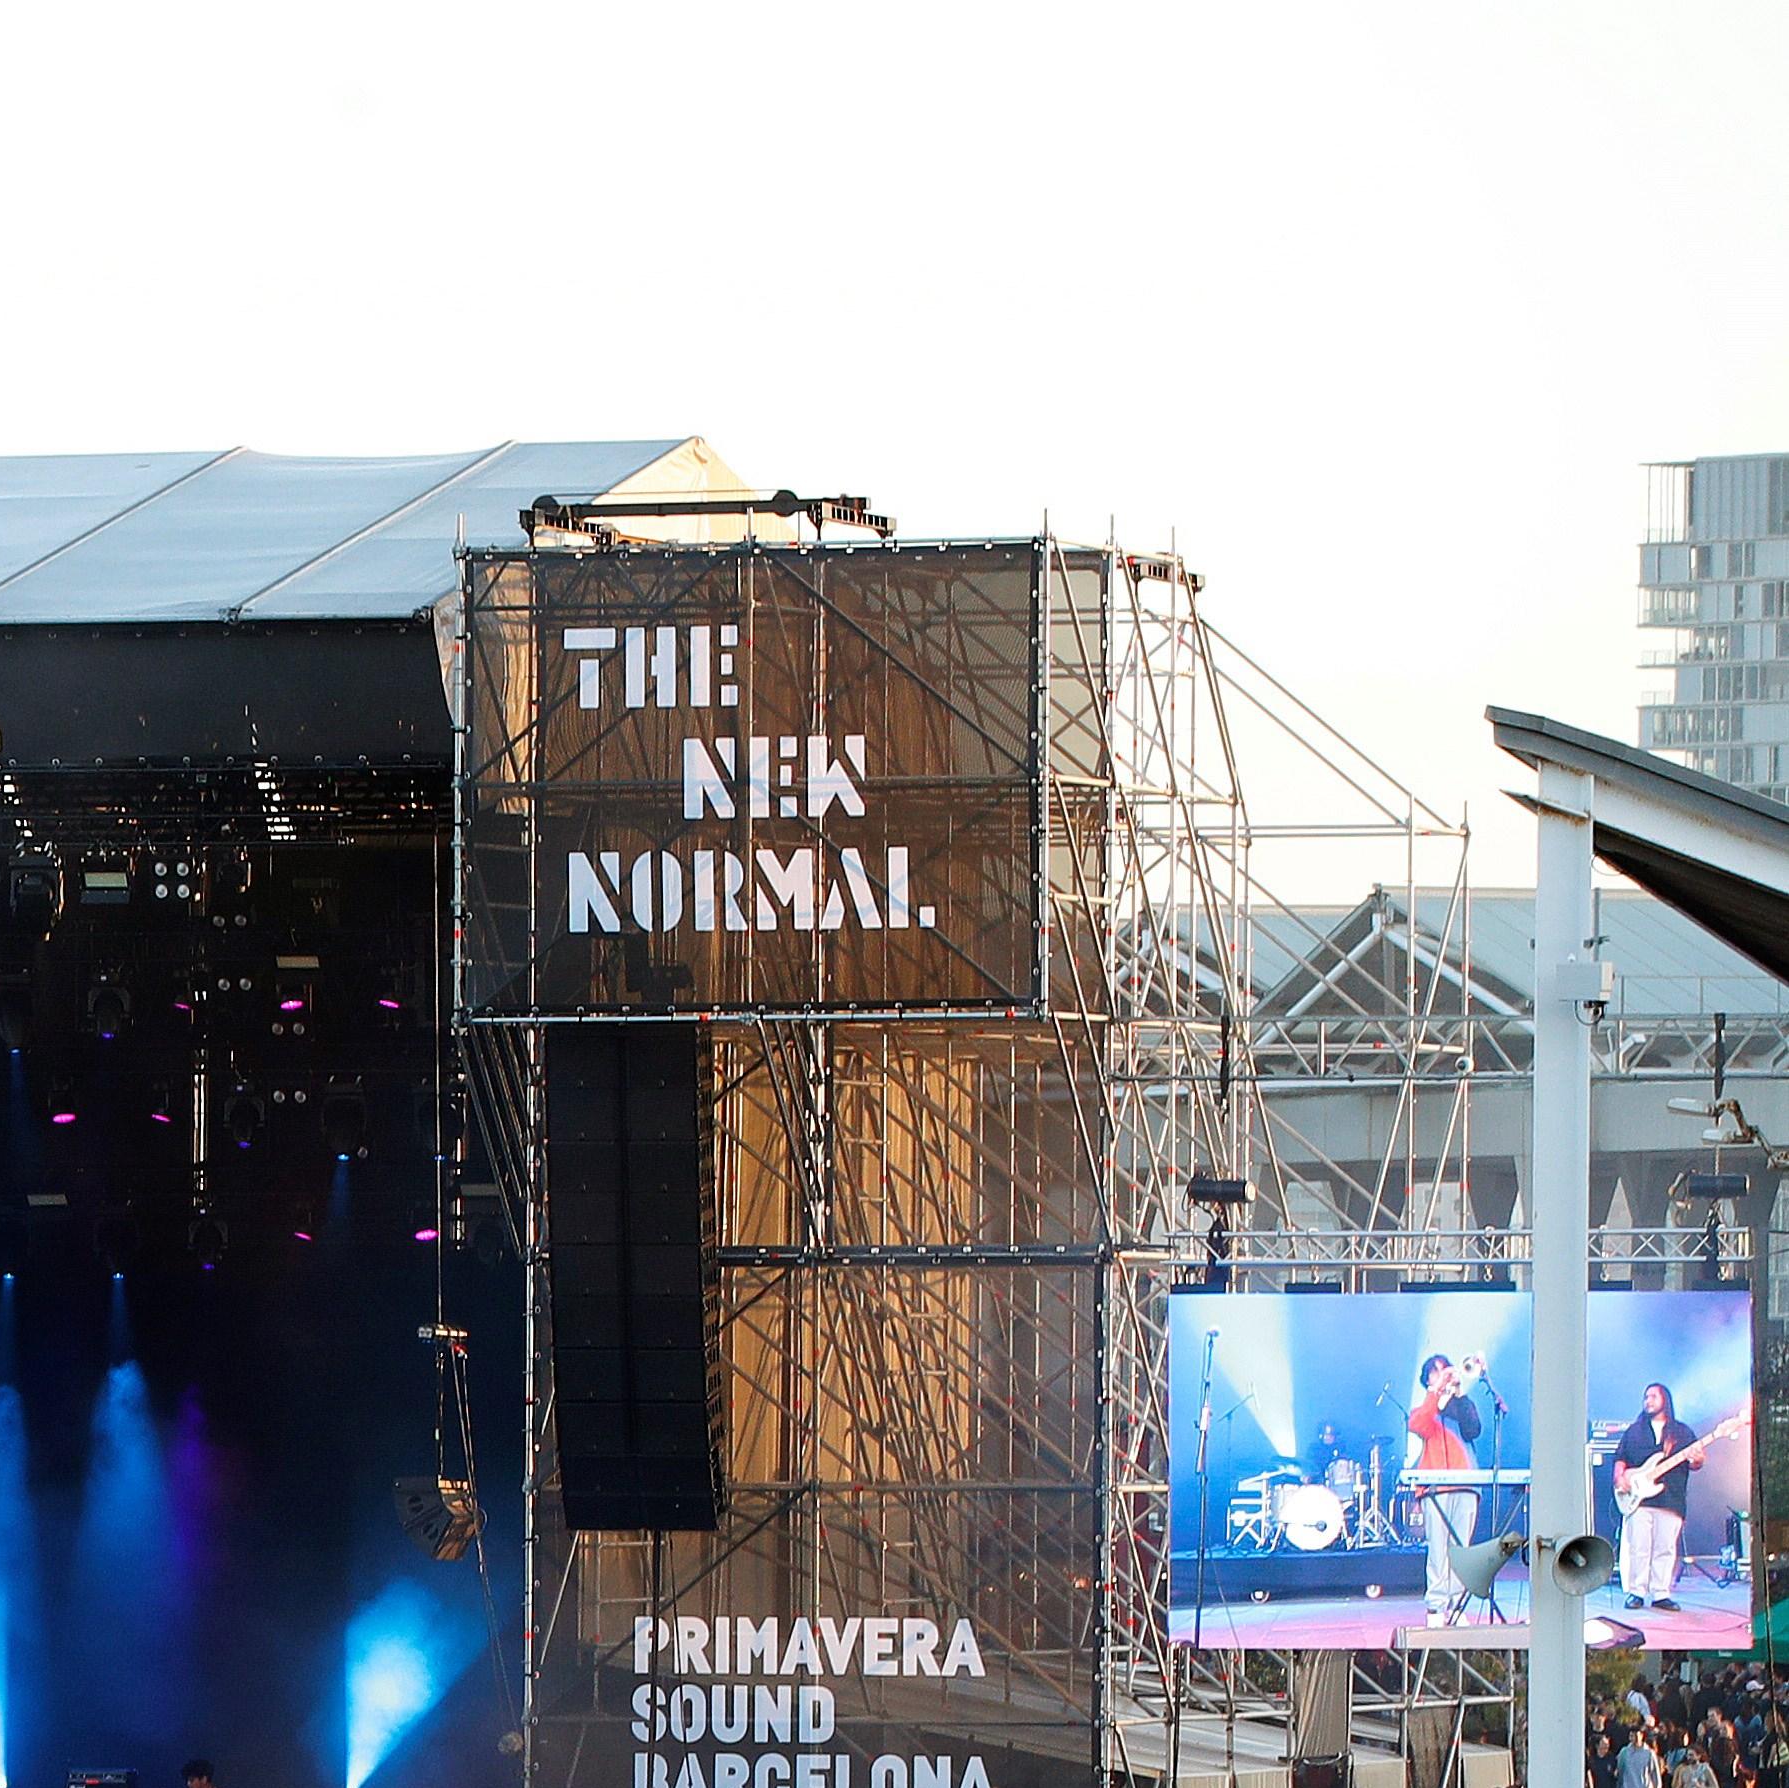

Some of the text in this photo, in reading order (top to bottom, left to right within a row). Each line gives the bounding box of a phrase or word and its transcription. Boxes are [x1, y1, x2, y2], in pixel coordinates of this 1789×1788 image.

[563, 624, 738, 709] THE
[683, 734, 866, 819] NEW
[568, 846, 936, 933] NORMAL
[633, 1616, 986, 1677] PRIMAVERA
[631, 1683, 836, 1745] SOUND
